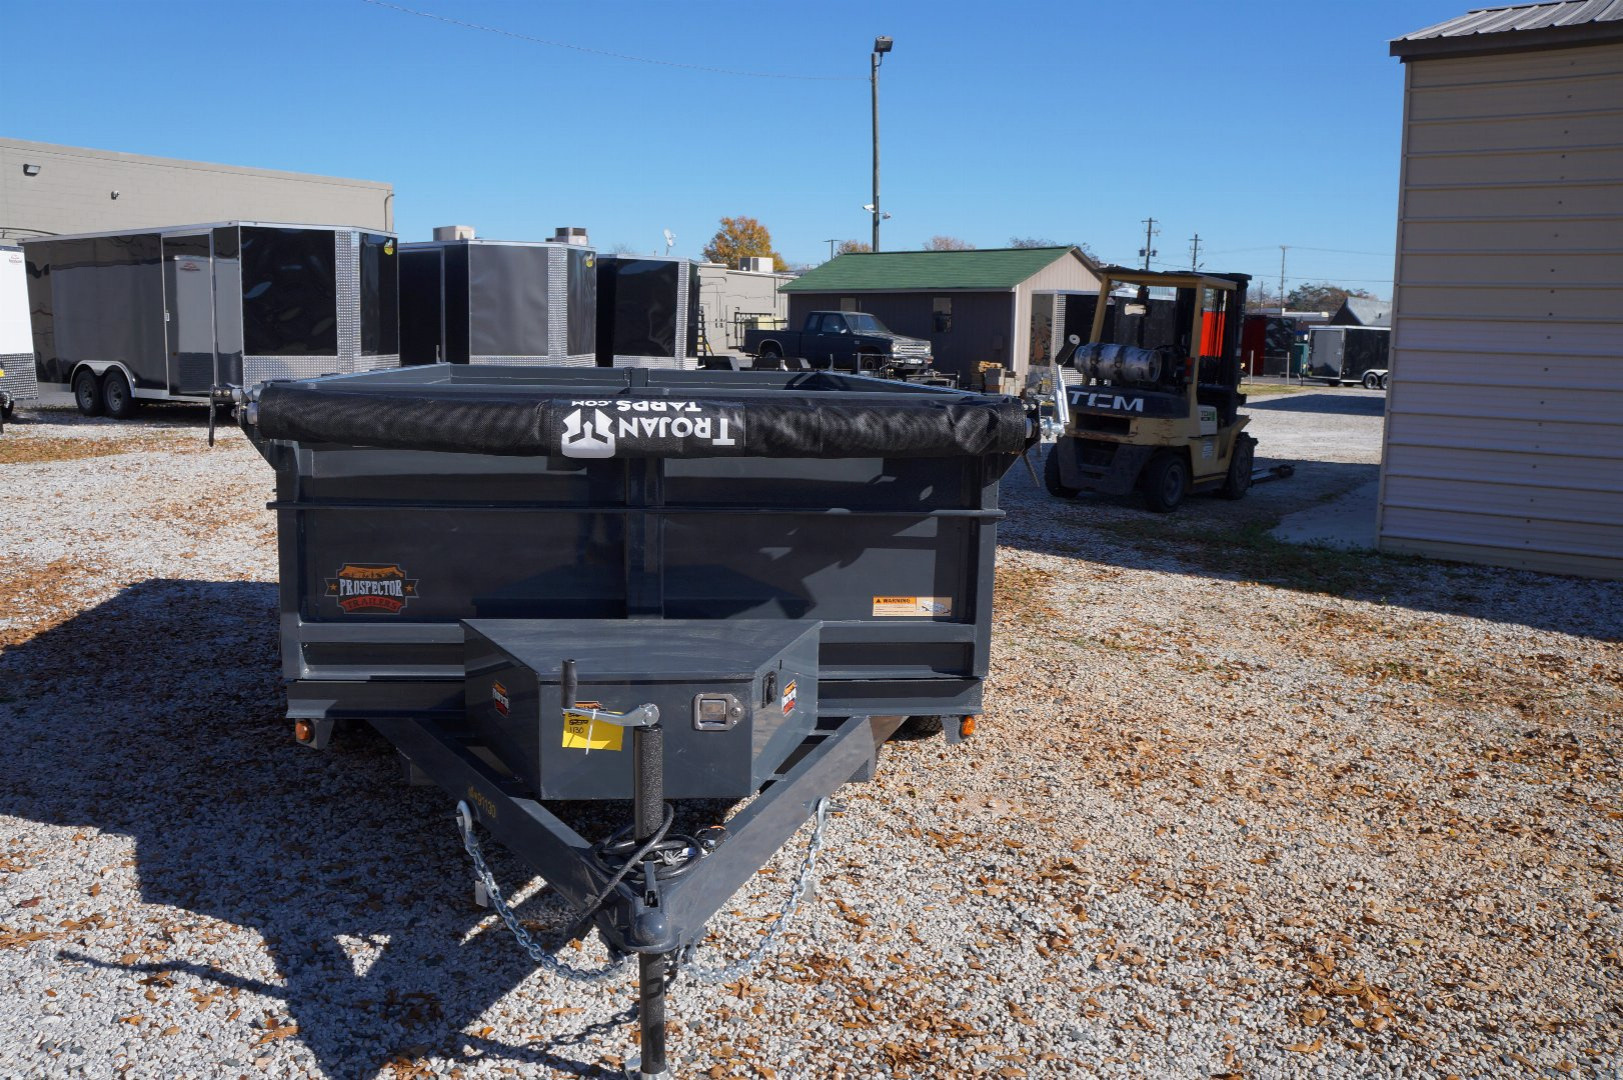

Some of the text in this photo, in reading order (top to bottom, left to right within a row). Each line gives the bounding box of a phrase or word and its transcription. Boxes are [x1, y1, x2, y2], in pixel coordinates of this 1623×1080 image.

[1068, 390, 1144, 412] TCM
[618, 417, 736, 446] TROJAN
[339, 579, 403, 597] PROSPECTOR
[347, 596, 398, 611] TRAILERS
